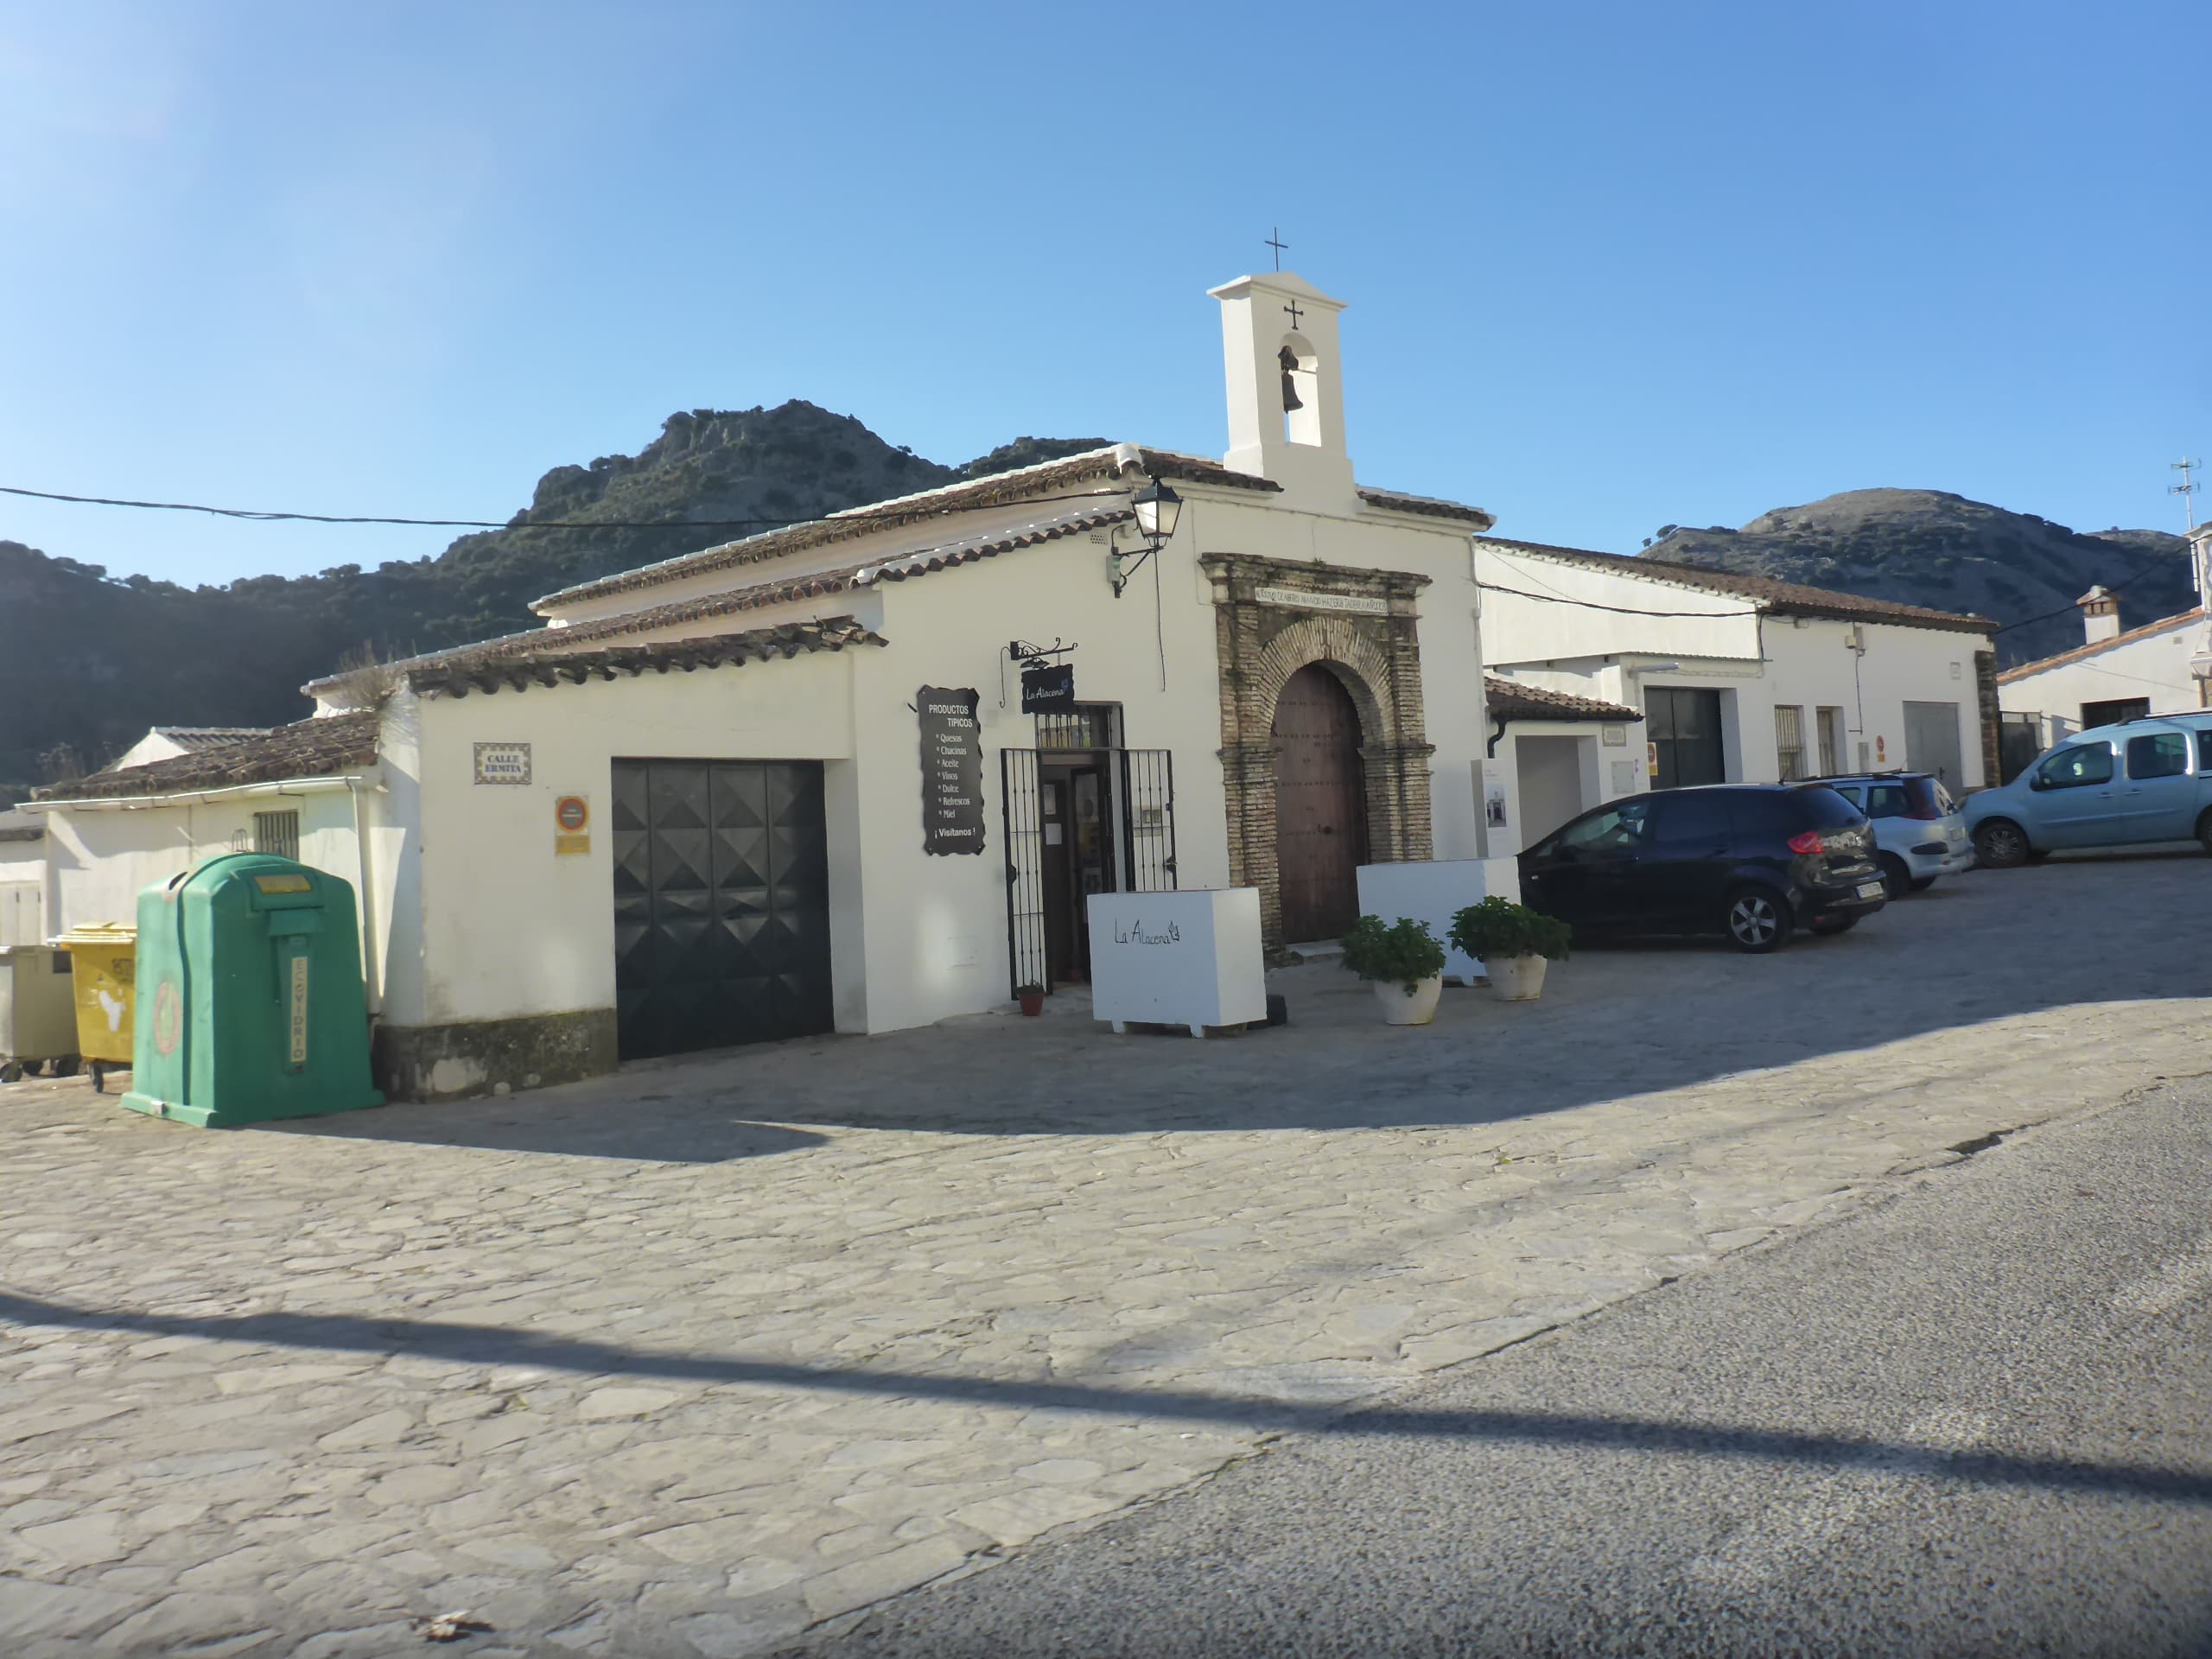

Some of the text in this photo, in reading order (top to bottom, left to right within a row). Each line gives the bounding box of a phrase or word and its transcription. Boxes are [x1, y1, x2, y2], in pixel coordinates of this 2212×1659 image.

[928, 704, 969, 715] PRODUCTOS
[947, 717, 973, 728] TIPICOS
[940, 733, 963, 744] Quesos
[940, 746, 967, 755] Chacinas
[486, 754, 519, 763] CALLE
[485, 764, 522, 773] ERMITA
[941, 760, 959, 768] Aceite
[942, 771, 958, 780] Vinos
[942, 784, 959, 793] Dulce
[943, 797, 970, 806] Refrescos
[943, 810, 956, 819] Miel
[1115, 918, 1171, 945] La Alacena
